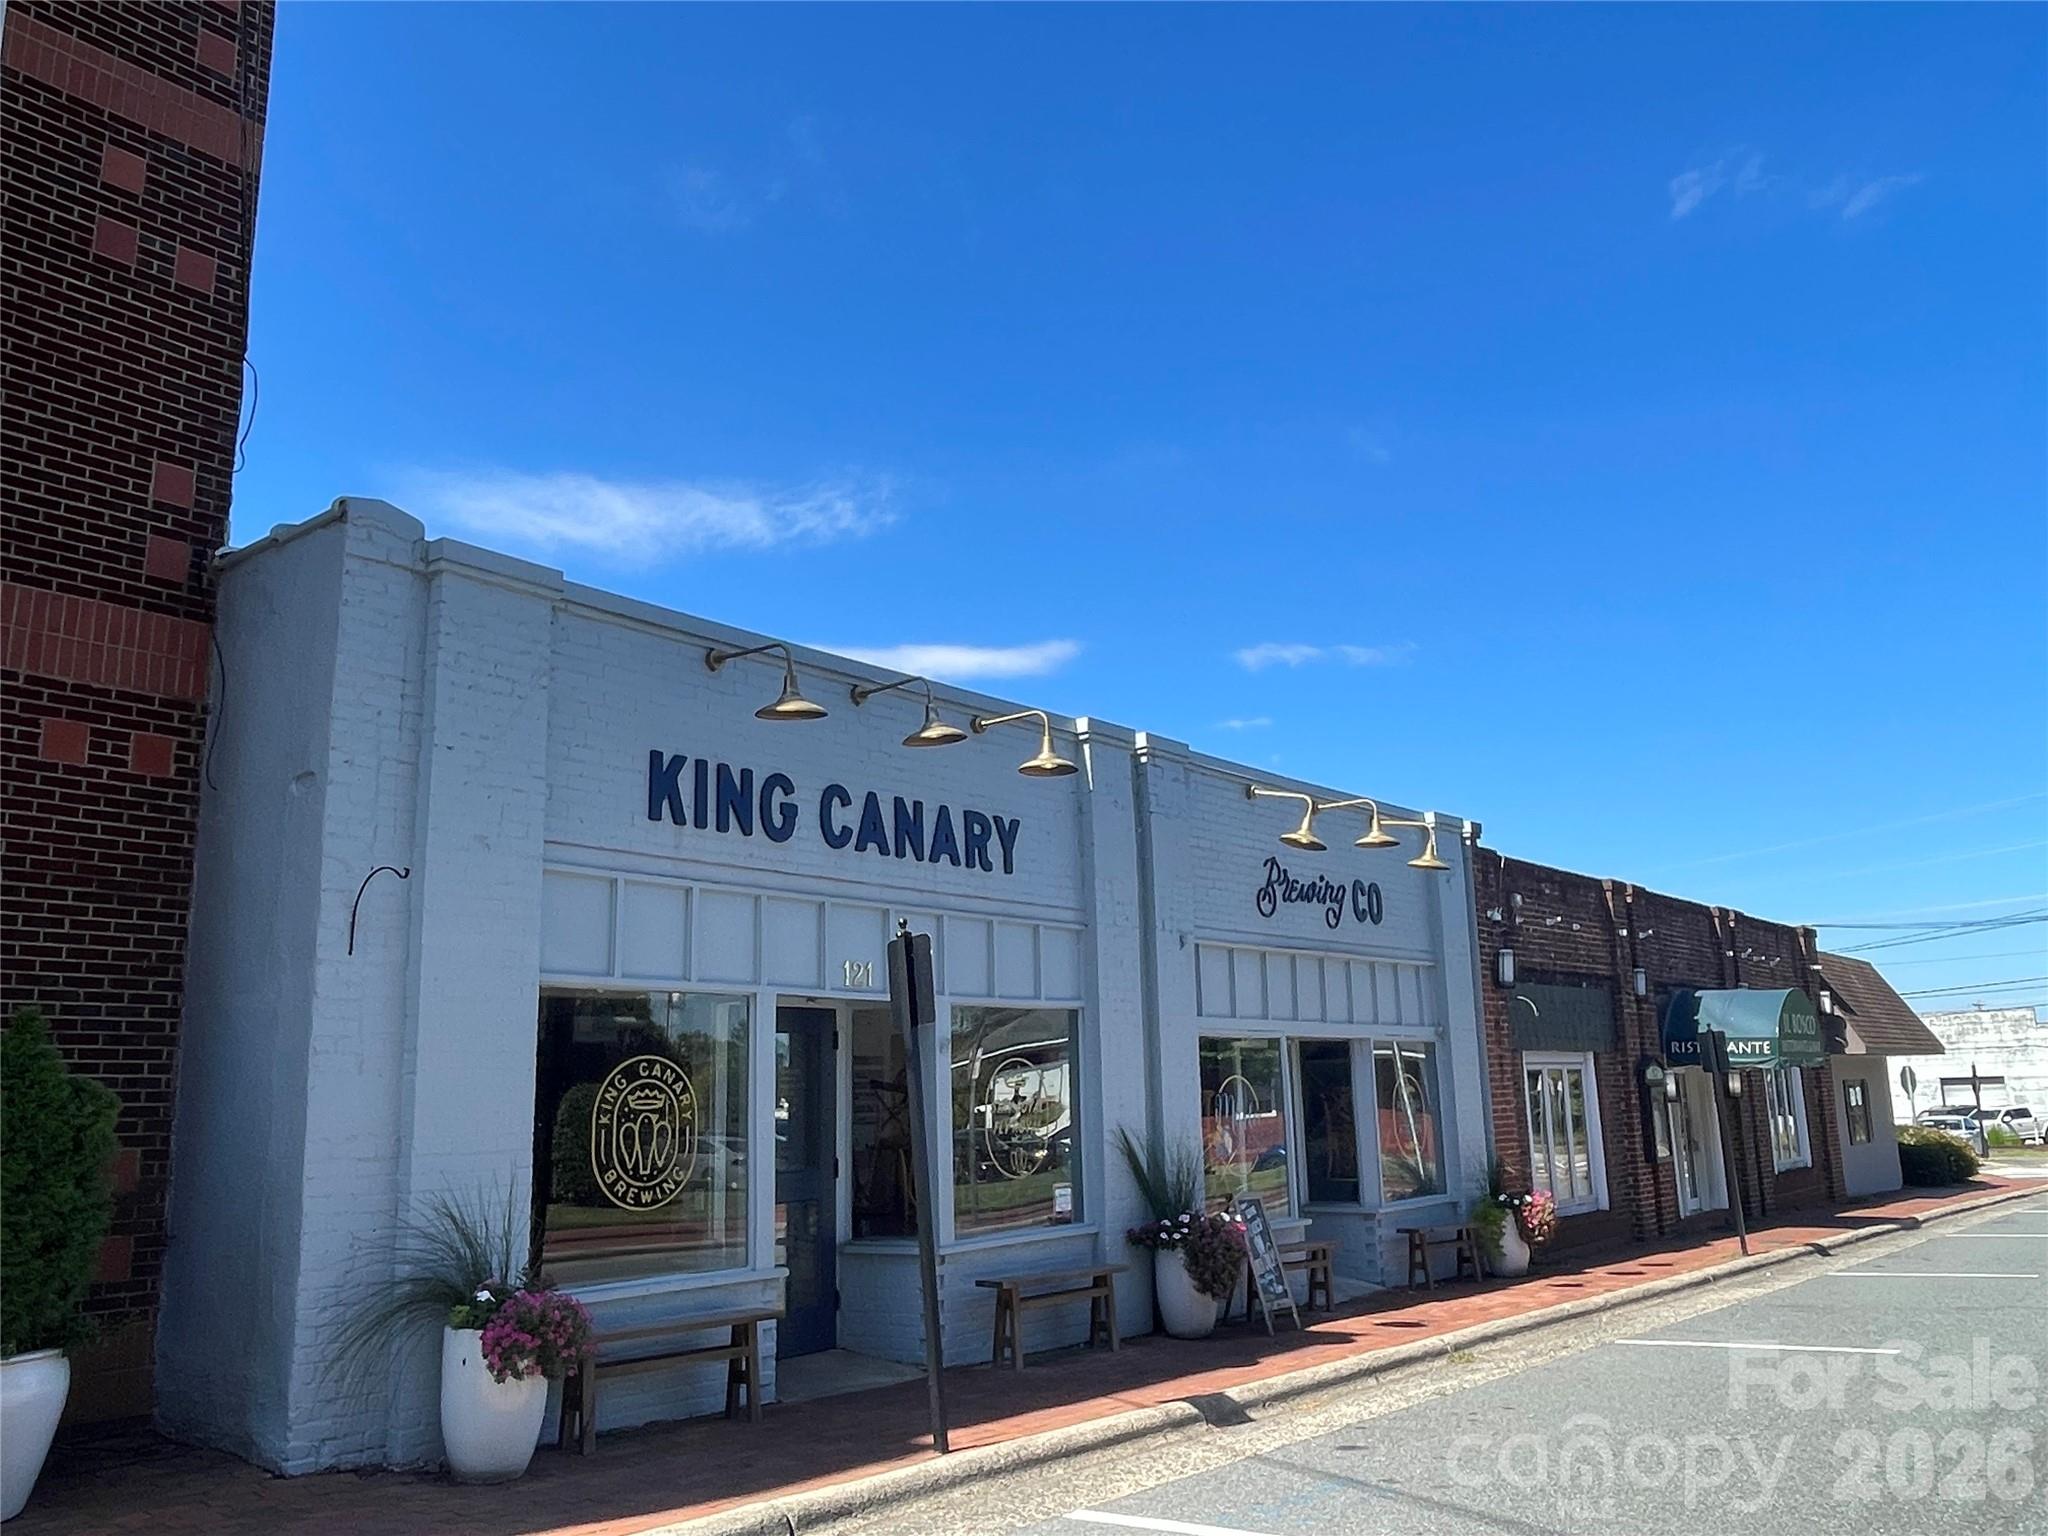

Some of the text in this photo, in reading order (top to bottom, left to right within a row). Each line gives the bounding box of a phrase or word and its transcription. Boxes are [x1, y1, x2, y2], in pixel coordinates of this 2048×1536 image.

[647, 749, 1021, 875] KING CANARY
[1257, 856, 1384, 930] Brewing CO
[843, 959, 873, 987] 121
[1671, 1040, 1771, 1054] RISTANTE
[598, 1062, 693, 1124] KING CANARY
[604, 1166, 684, 1204] BREWING
